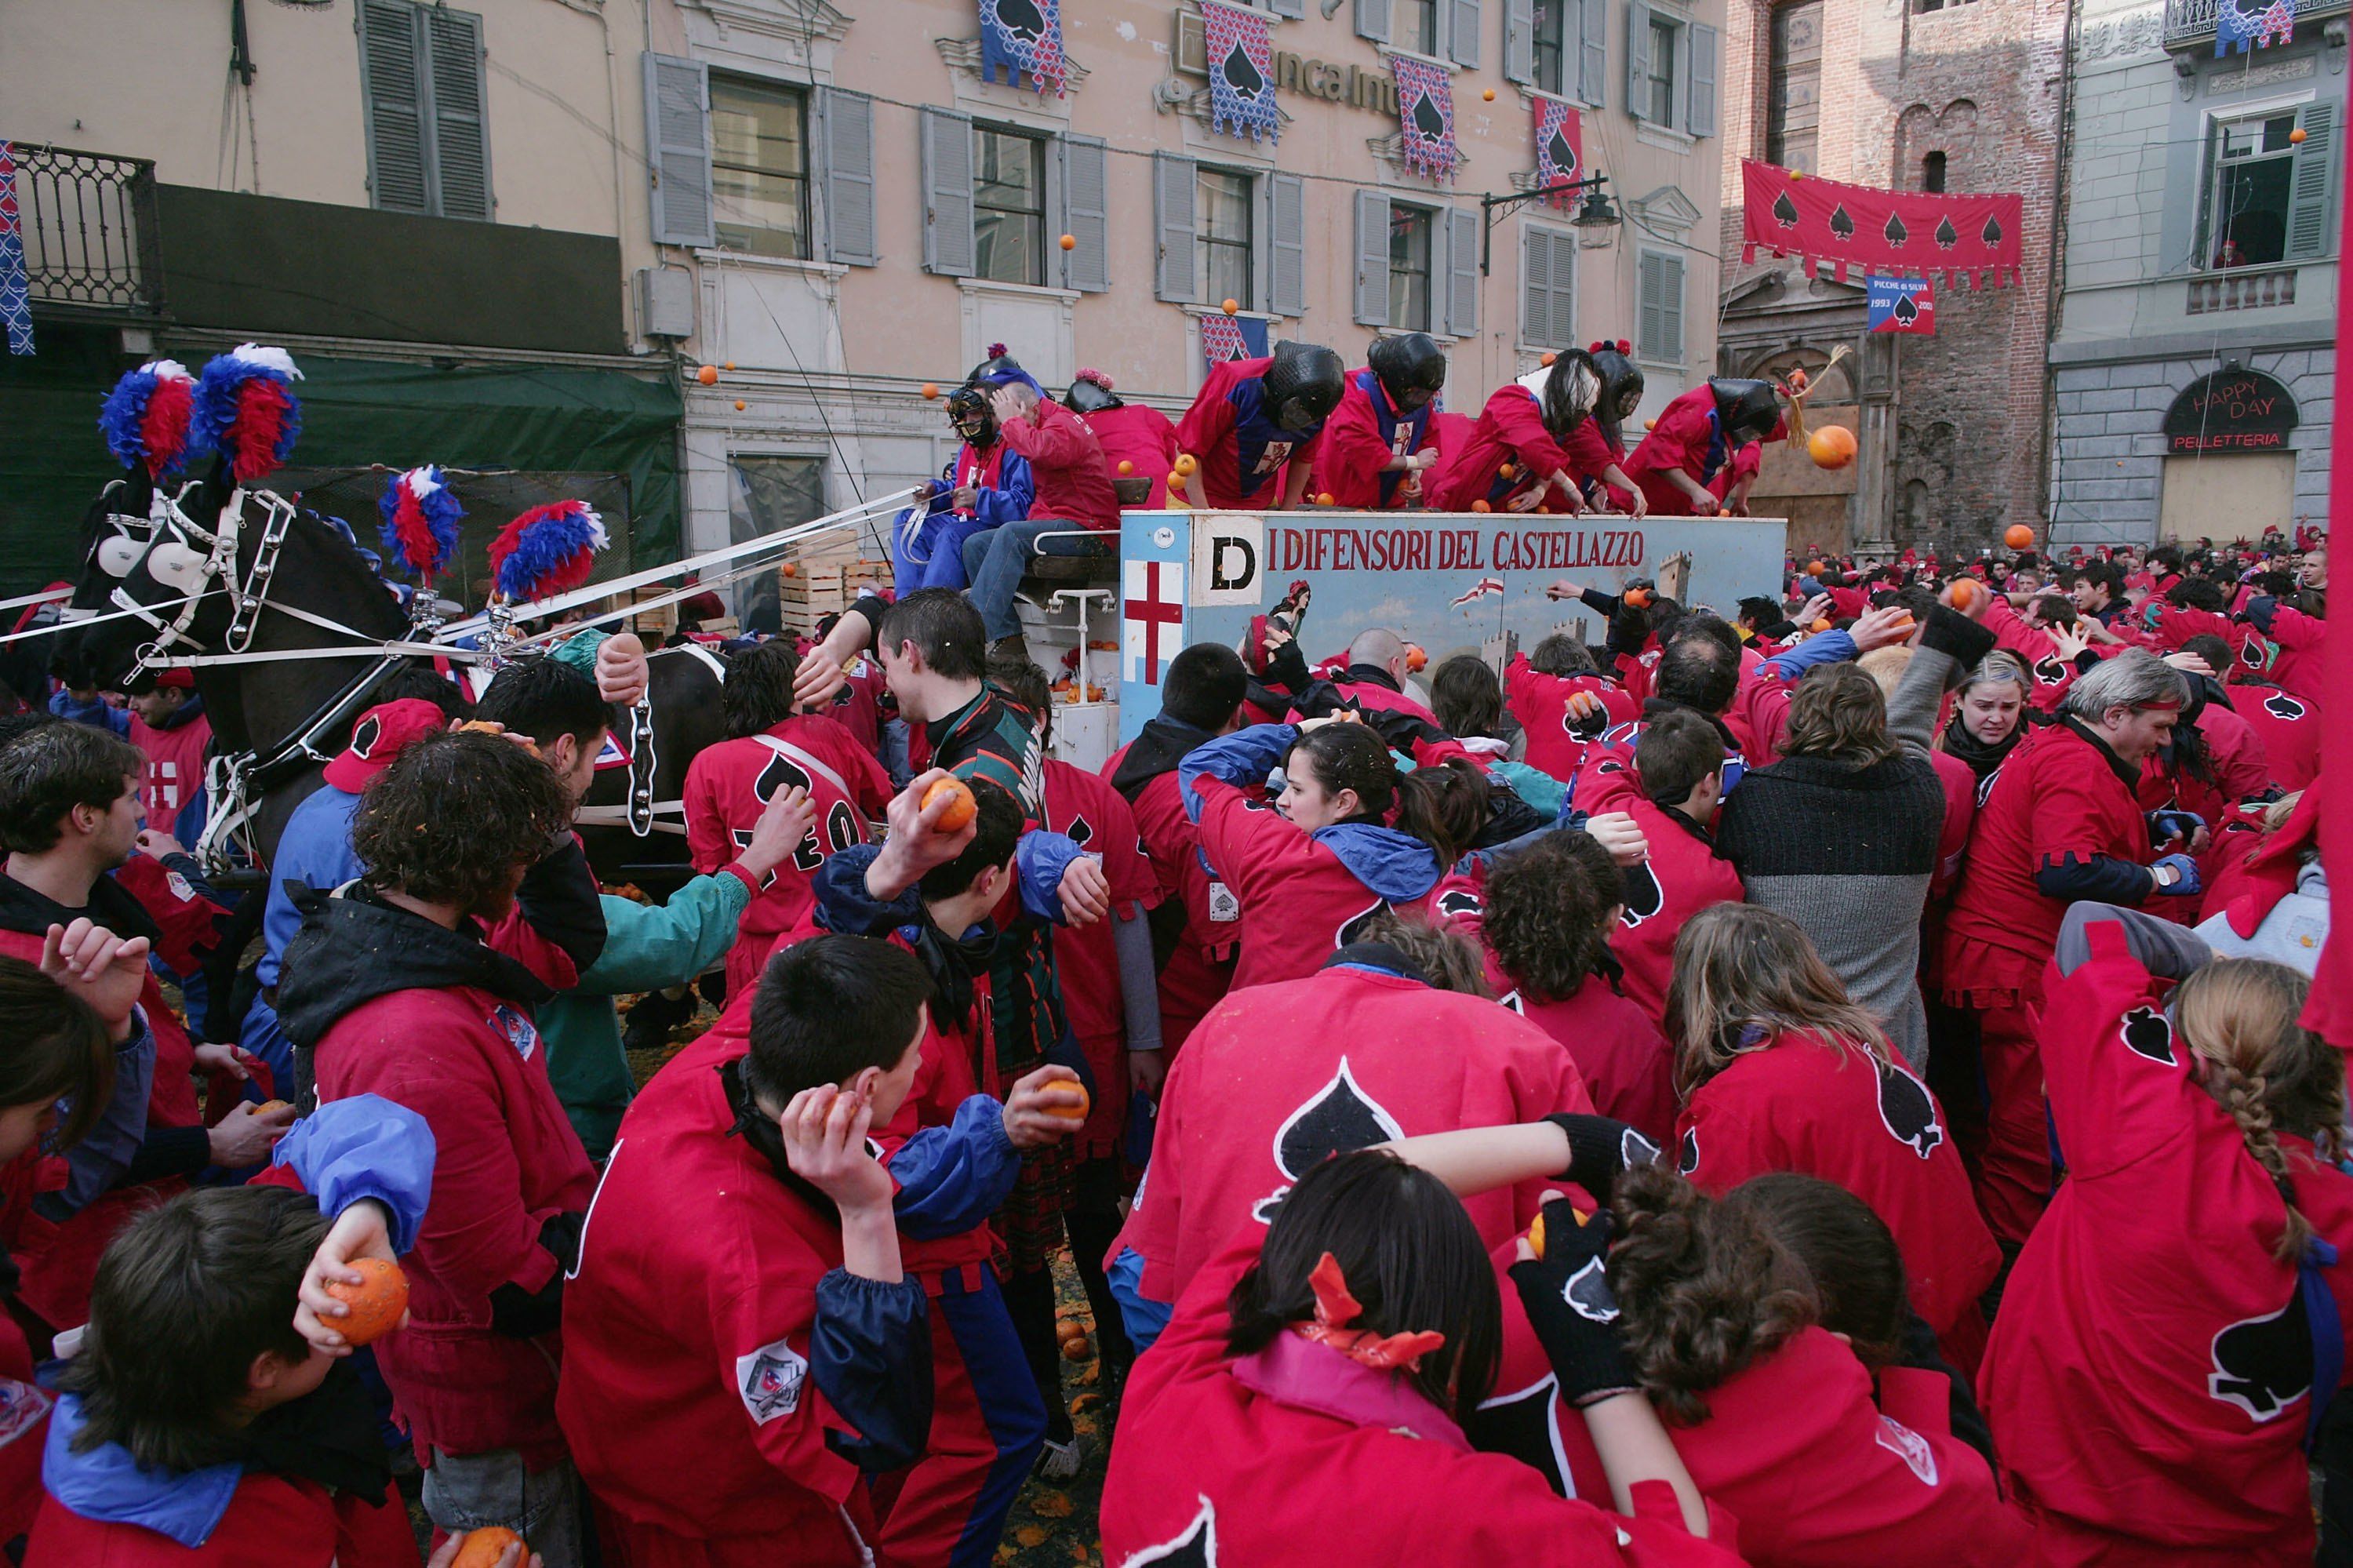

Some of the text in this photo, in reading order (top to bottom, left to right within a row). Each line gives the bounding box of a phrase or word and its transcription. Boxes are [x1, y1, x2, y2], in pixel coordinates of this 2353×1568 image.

[1873, 280, 1899, 289] PICCHE
[1871, 299, 1891, 307] 1993
[2192, 378, 2258, 413] HAPPY
[2230, 397, 2275, 419] DAY
[2174, 433, 2280, 449] PELLETTERIA
[1267, 528, 1644, 571] I DIFENSORI DEL CASTELLAZZO
[1210, 537, 1256, 590] D
